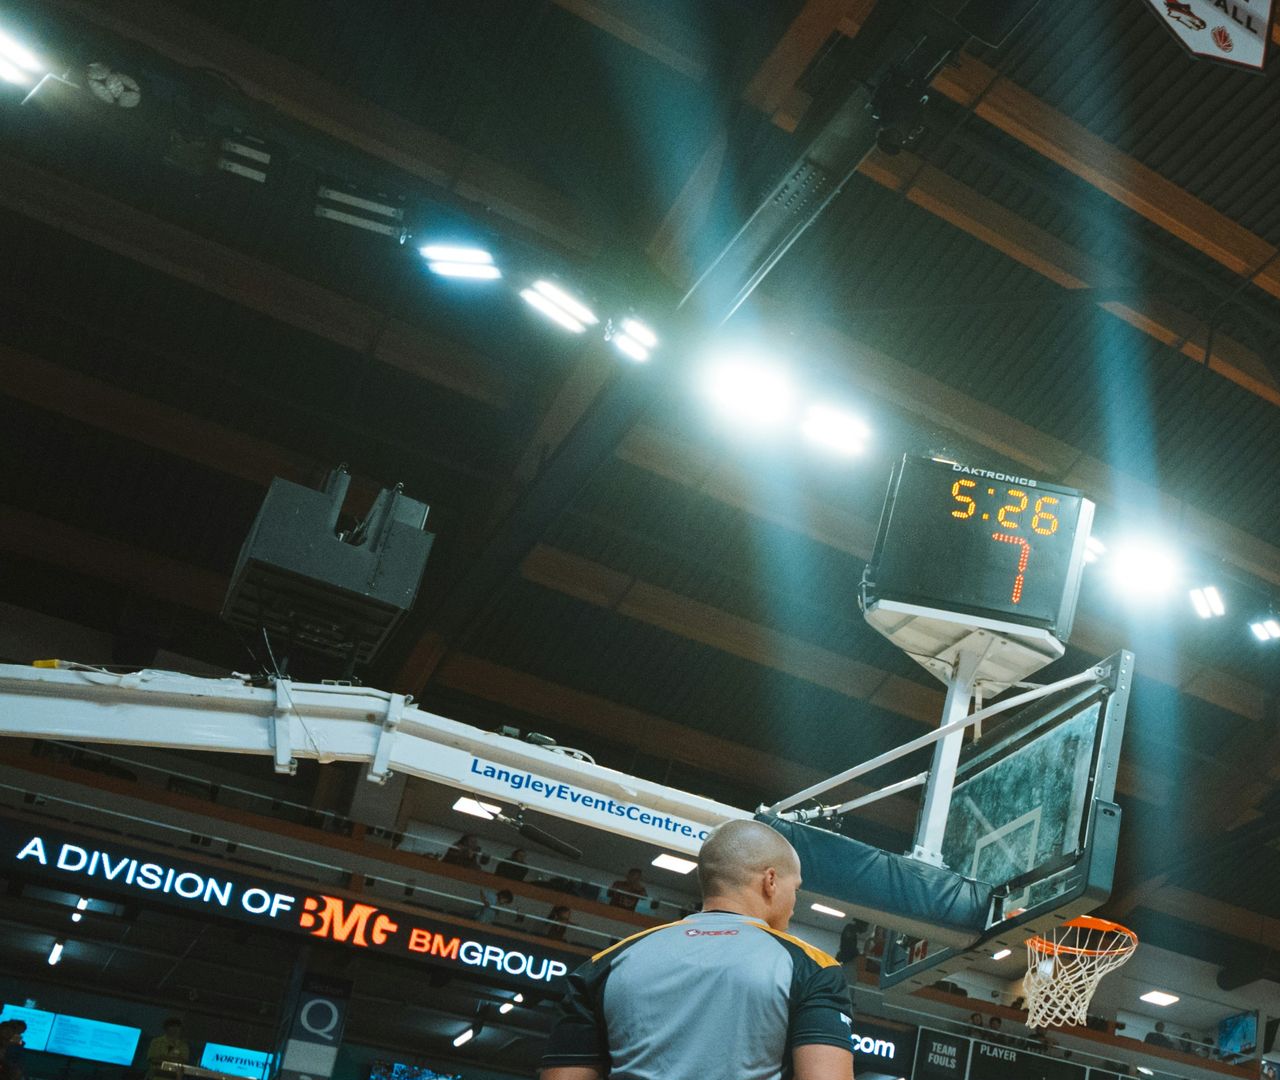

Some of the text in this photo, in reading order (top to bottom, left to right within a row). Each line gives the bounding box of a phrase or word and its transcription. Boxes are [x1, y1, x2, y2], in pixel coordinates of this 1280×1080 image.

[953, 462, 1037, 488] DAKTRONICS
[951, 478, 1060, 536] 5:26
[992, 532, 1031, 605] 7
[16, 836, 48, 865] A
[56, 843, 233, 906] DIVISION
[241, 888, 296, 917] OF
[407, 927, 568, 983] BMGROUP
[300, 999, 339, 1041] Q
[927, 1052, 957, 1070] FOULS
[931, 1041, 957, 1058] TEAM
[980, 1043, 1018, 1063] PLAYER
